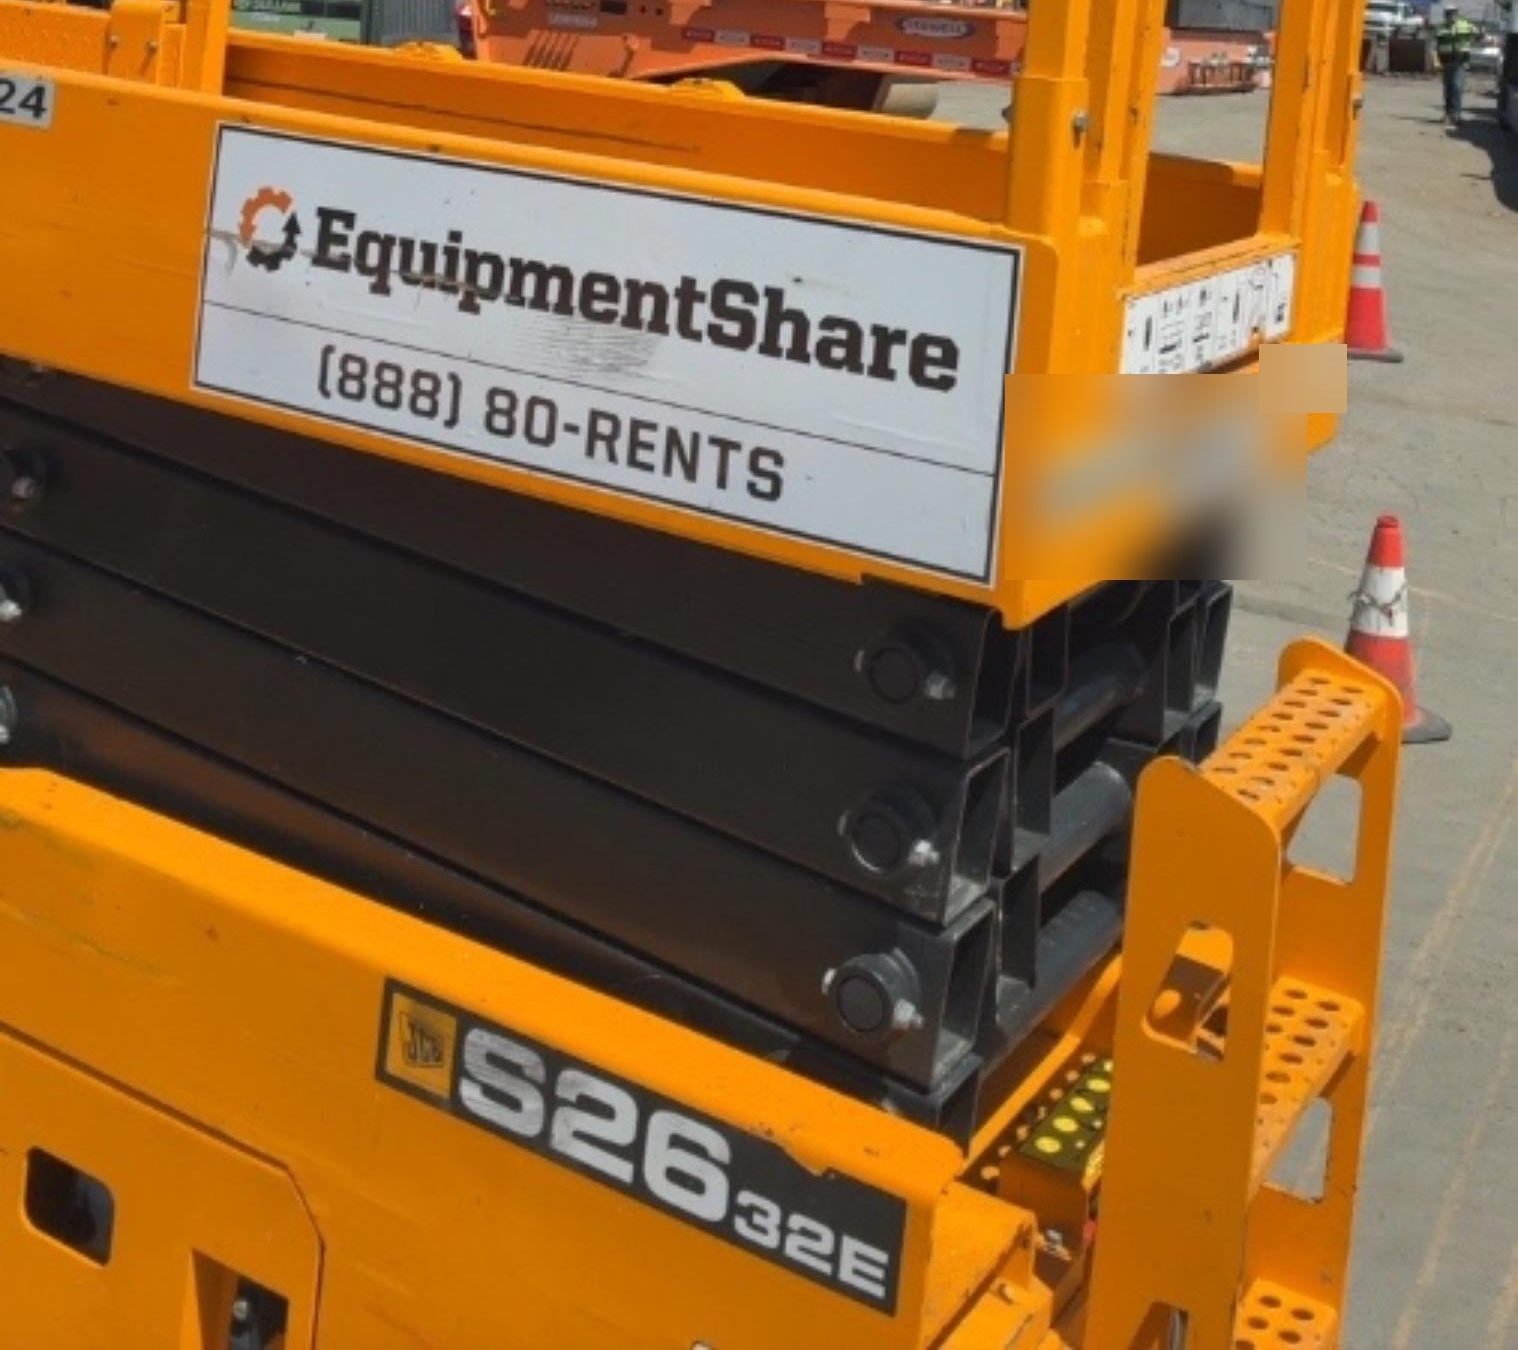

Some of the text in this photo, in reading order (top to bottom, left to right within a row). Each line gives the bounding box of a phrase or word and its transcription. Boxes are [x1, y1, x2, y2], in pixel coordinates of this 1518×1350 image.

[312, 207, 960, 391] EquipmentShare
[318, 344, 786, 502] (888) 80-RENTS
